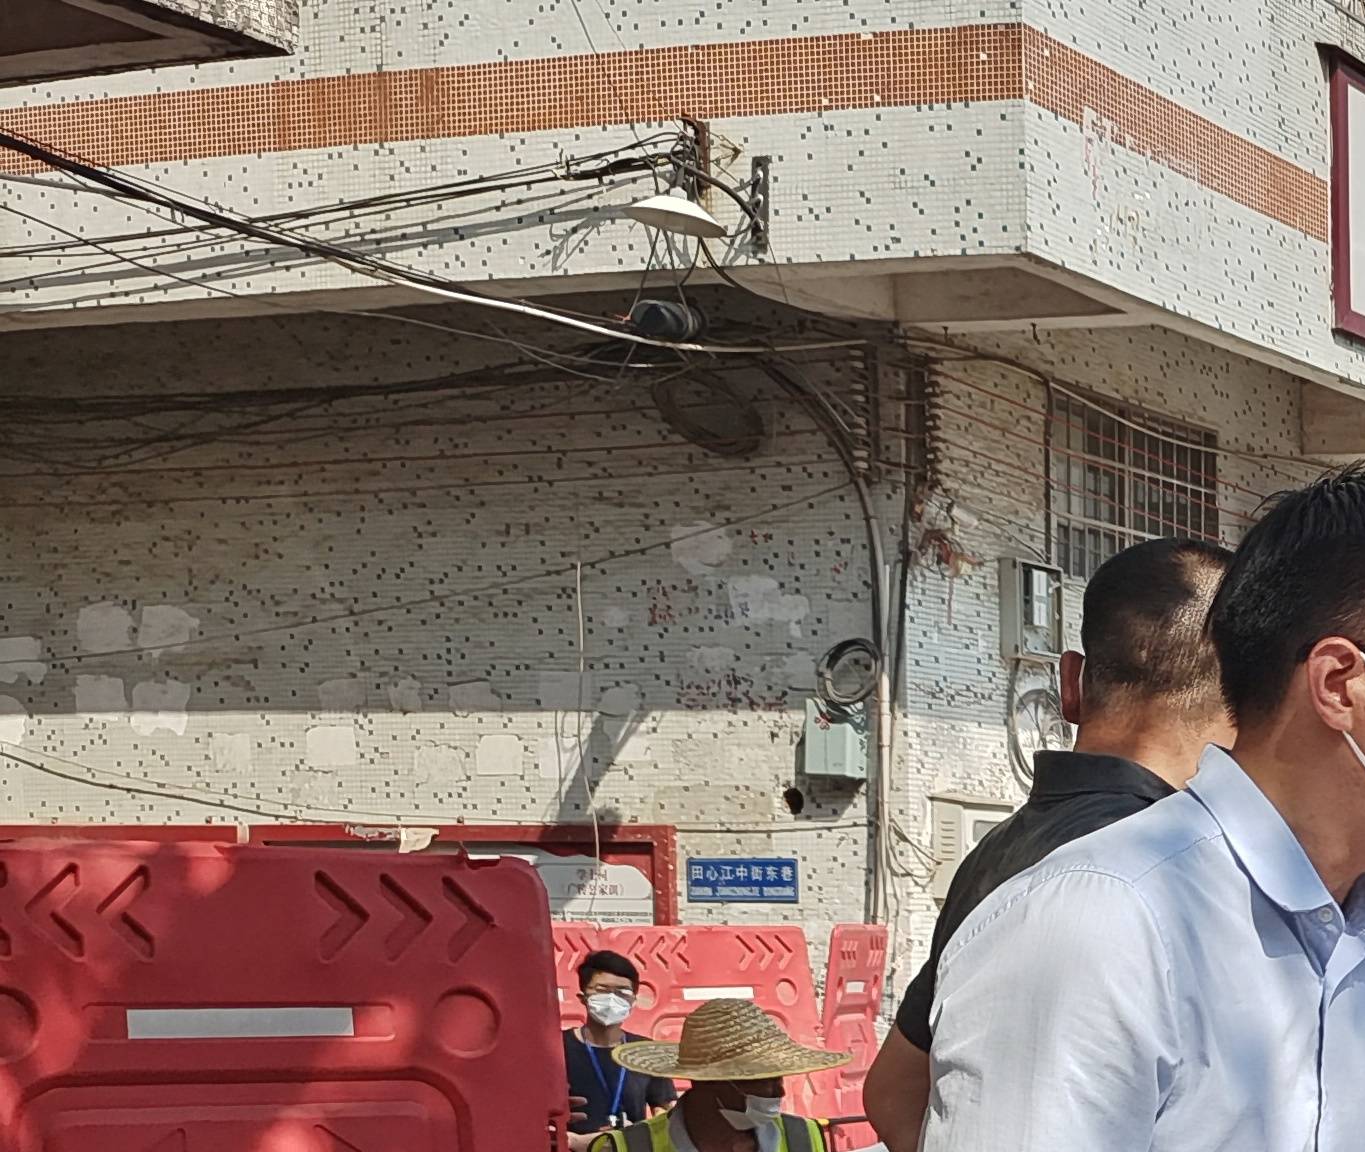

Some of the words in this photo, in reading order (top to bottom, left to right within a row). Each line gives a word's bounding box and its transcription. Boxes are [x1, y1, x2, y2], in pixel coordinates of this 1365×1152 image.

[691, 864, 794, 881] 田心江中街东巷
